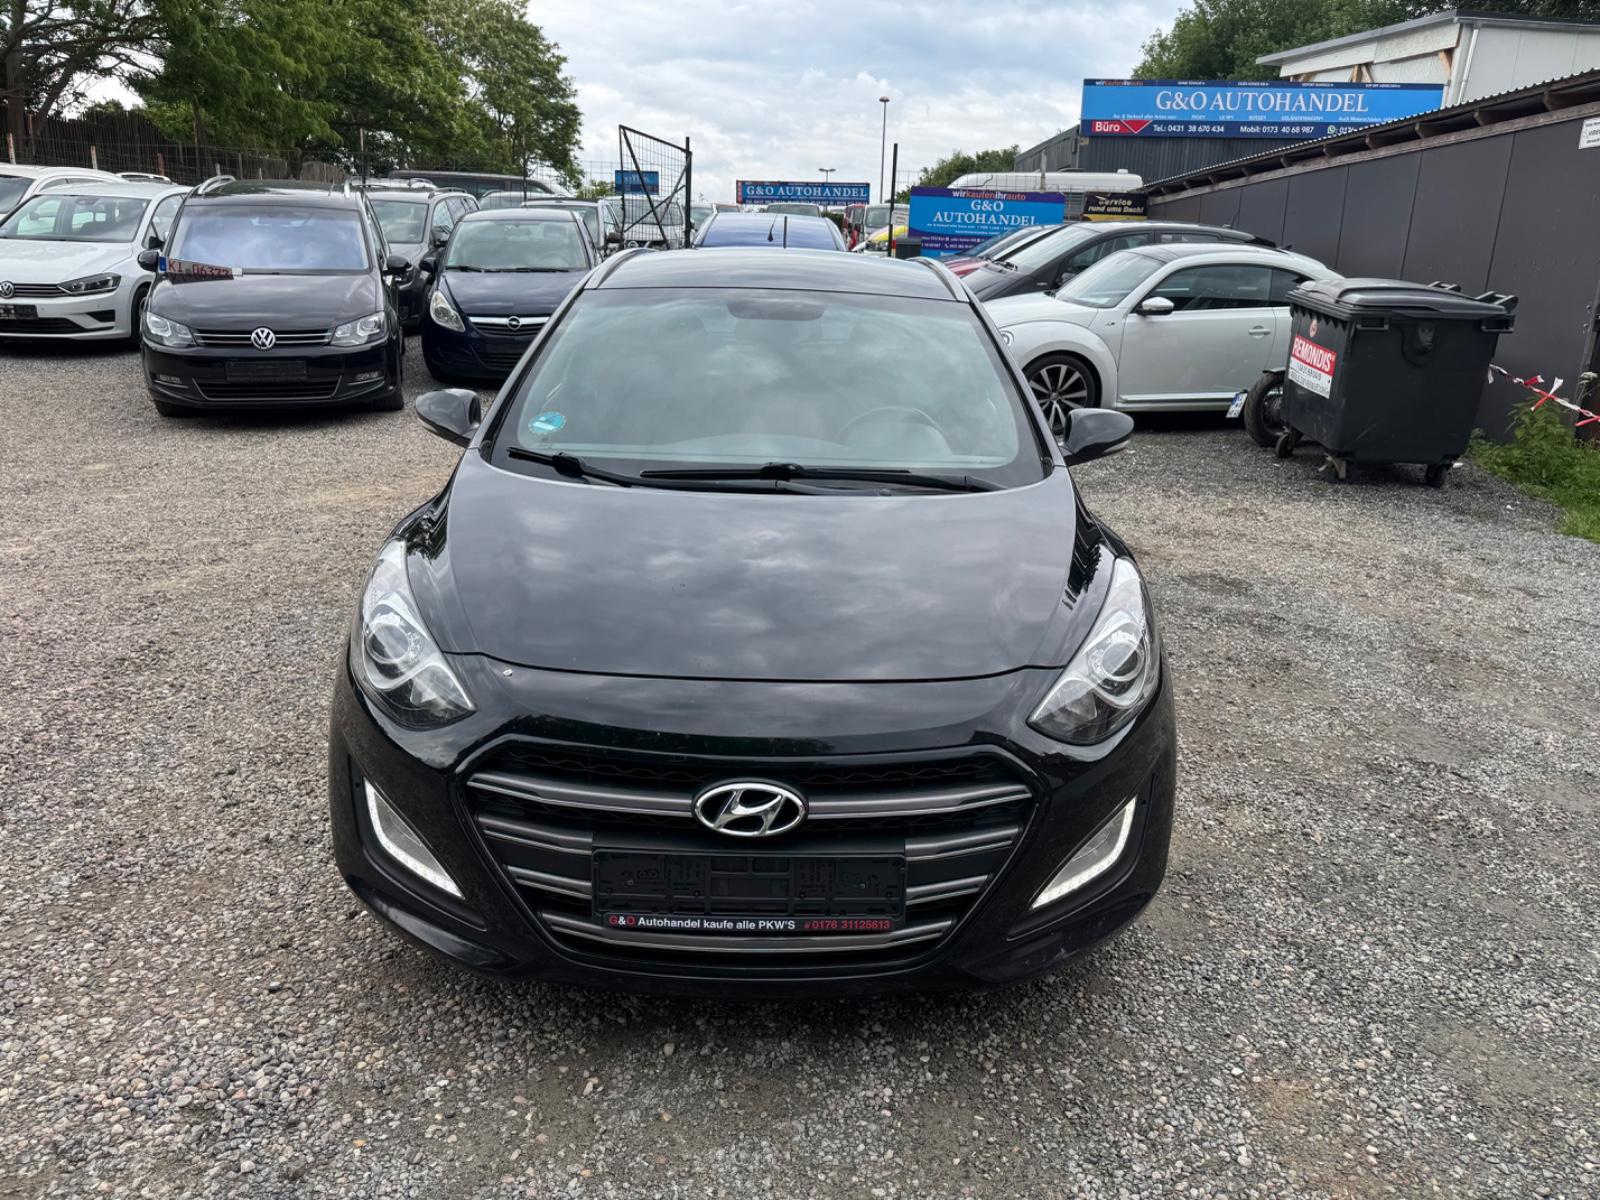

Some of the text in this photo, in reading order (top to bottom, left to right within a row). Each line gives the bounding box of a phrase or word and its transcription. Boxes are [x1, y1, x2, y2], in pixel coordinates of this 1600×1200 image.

[1156, 90, 1369, 112] G&O AUTOHANDEL
[1095, 121, 1120, 132] Büro
[1240, 125, 1261, 133] Mobil:
[746, 186, 868, 197] G&O AUTOHANDEL
[952, 190, 1026, 201] wirkaufenihrauto
[970, 200, 1004, 212] G&O
[933, 210, 1039, 226] AUTOHANDEL
[1292, 337, 1333, 372] REMONDIS
[608, 916, 636, 926] G&O
[638, 916, 700, 928] Autohandel
[703, 919, 733, 930] kaufe
[736, 919, 755, 930] alle
[758, 920, 796, 930] PKW'S
